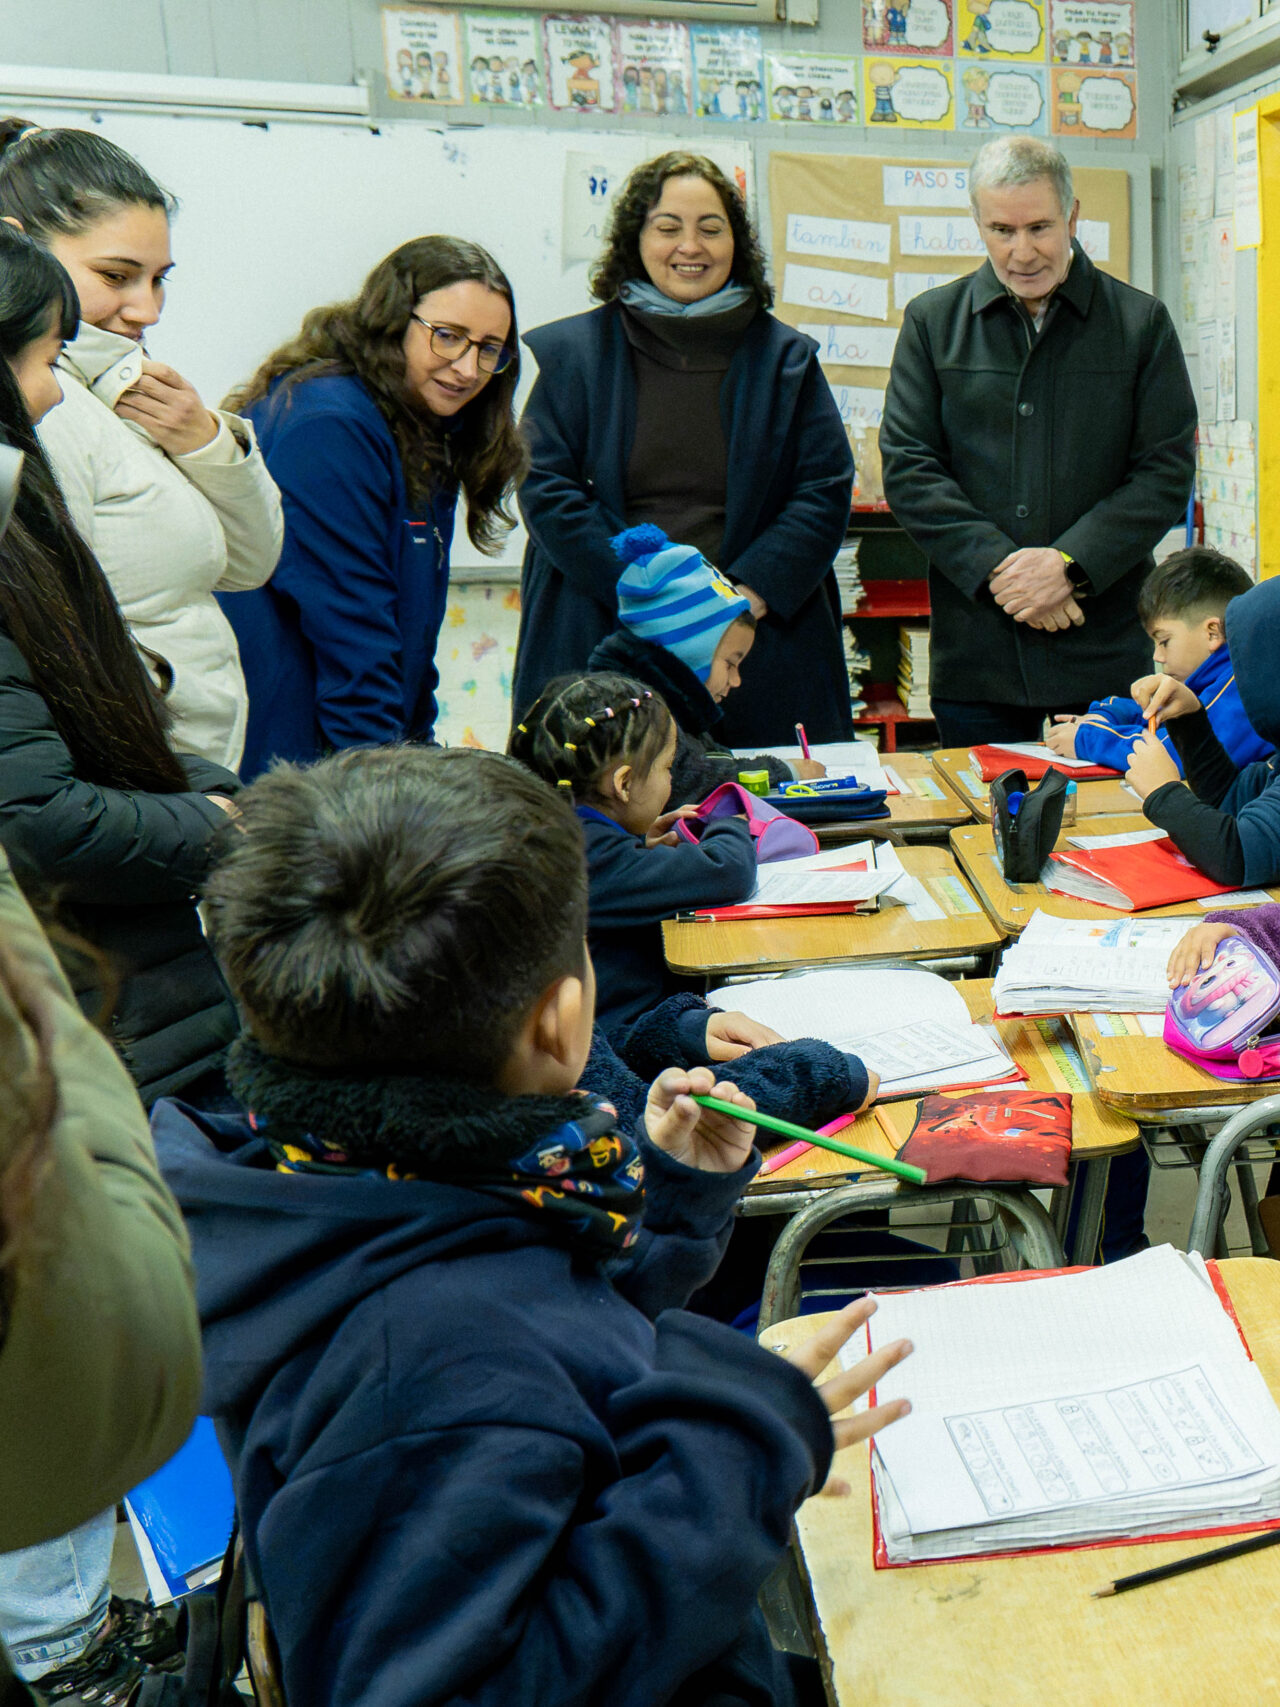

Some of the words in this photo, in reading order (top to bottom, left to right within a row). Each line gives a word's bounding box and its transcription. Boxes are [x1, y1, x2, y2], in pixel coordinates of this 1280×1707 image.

[905, 170, 947, 188] PASO
[954, 172, 966, 189] 5
[827, 325, 869, 359] ha
